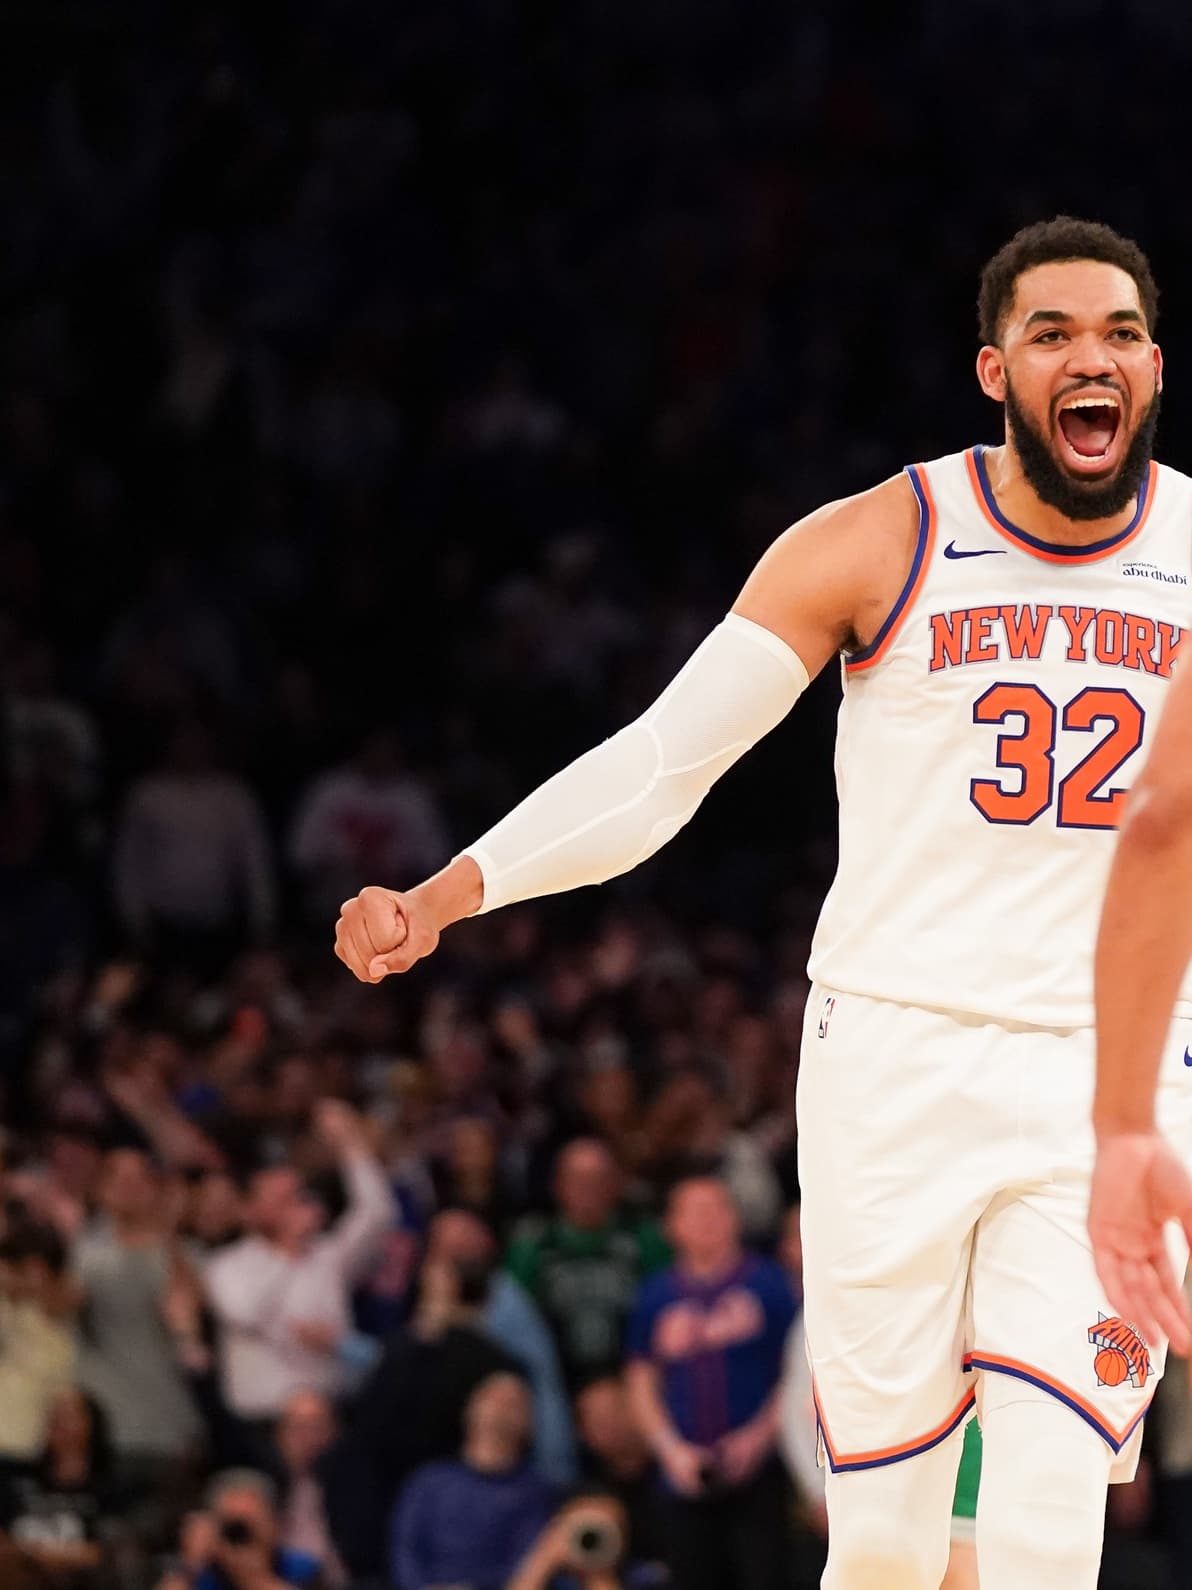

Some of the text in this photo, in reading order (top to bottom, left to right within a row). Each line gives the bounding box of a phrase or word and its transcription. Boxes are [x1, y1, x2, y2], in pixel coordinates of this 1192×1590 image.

[1122, 567, 1188, 585] abu dhabi
[928, 603, 1190, 679] NEW YORK
[970, 681, 1146, 830] 32
